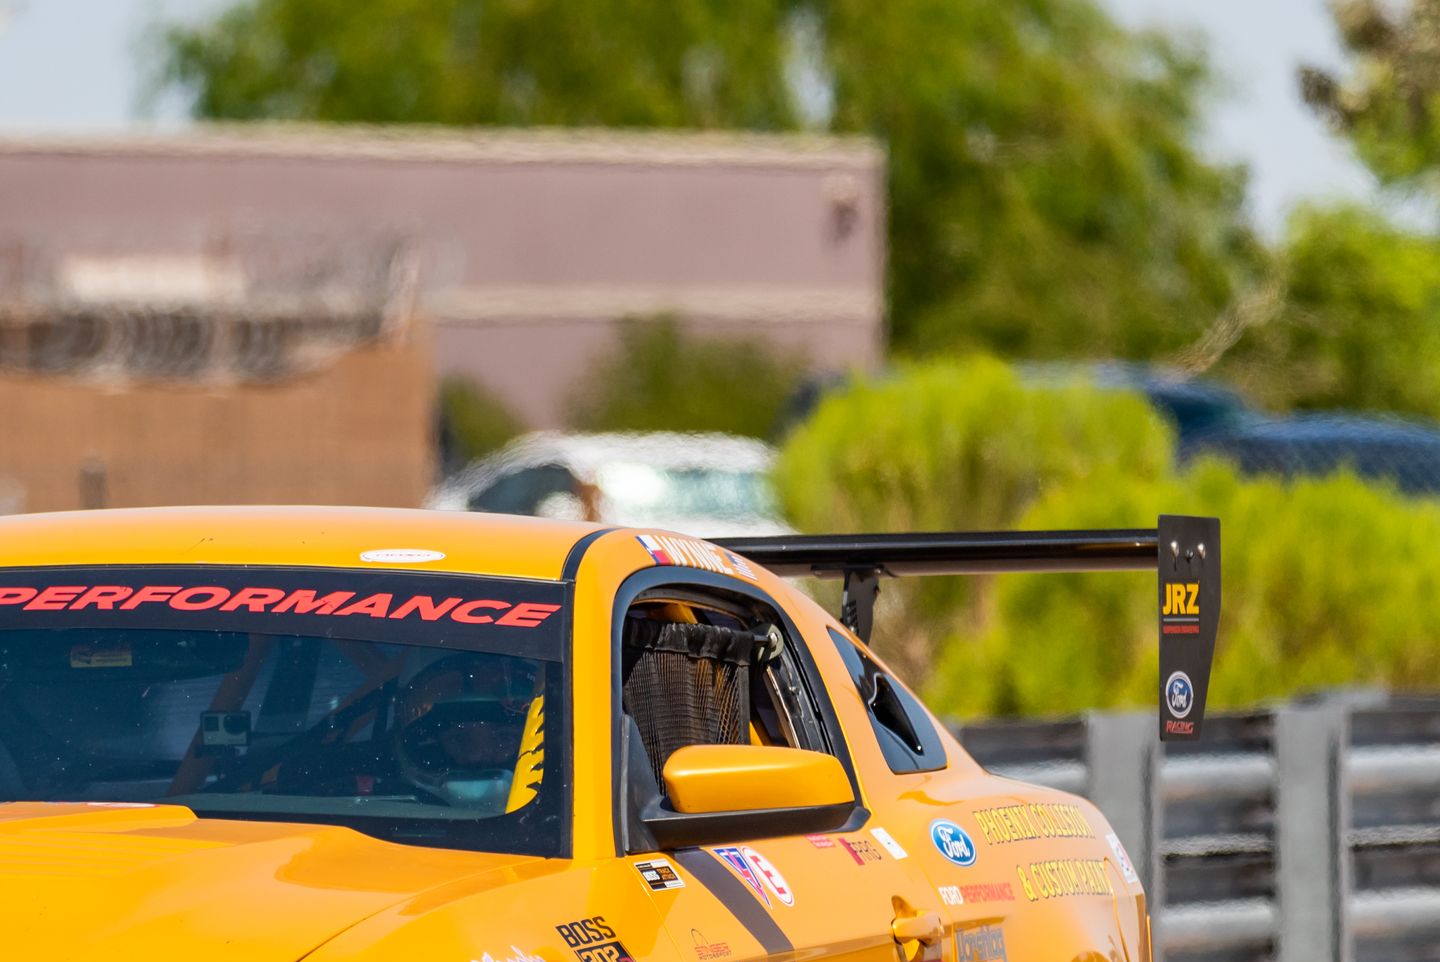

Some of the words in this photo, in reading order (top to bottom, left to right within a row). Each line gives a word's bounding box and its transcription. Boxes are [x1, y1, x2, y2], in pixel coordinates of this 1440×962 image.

[1162, 583, 1200, 616] JRZ
[972, 804, 1041, 845] PHOENIX
[1029, 803, 1096, 840] COLLISION
[941, 825, 971, 863] Ford
[938, 886, 964, 905] FORD
[1029, 860, 1077, 899] CUSTOM
[555, 916, 616, 948] BOSS
